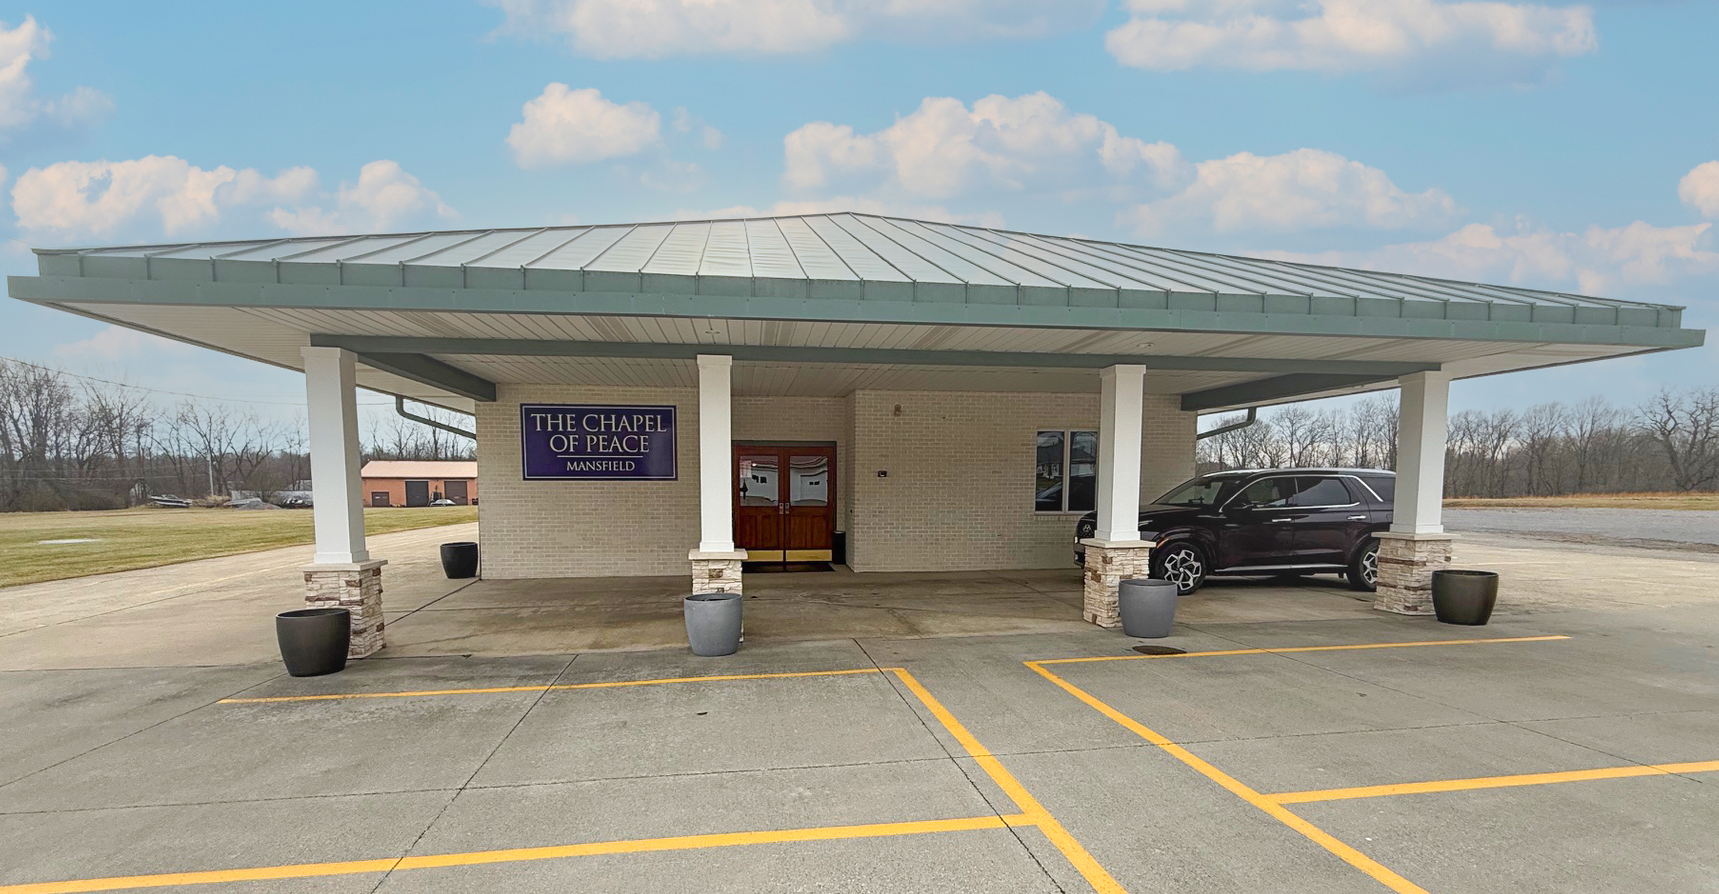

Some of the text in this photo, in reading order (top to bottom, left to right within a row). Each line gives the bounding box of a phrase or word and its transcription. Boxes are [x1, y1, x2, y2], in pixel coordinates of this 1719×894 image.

[531, 413, 667, 433] THE CHAPEL
[550, 434, 650, 453] OF PEACE
[566, 461, 635, 472] MANSFIELD
